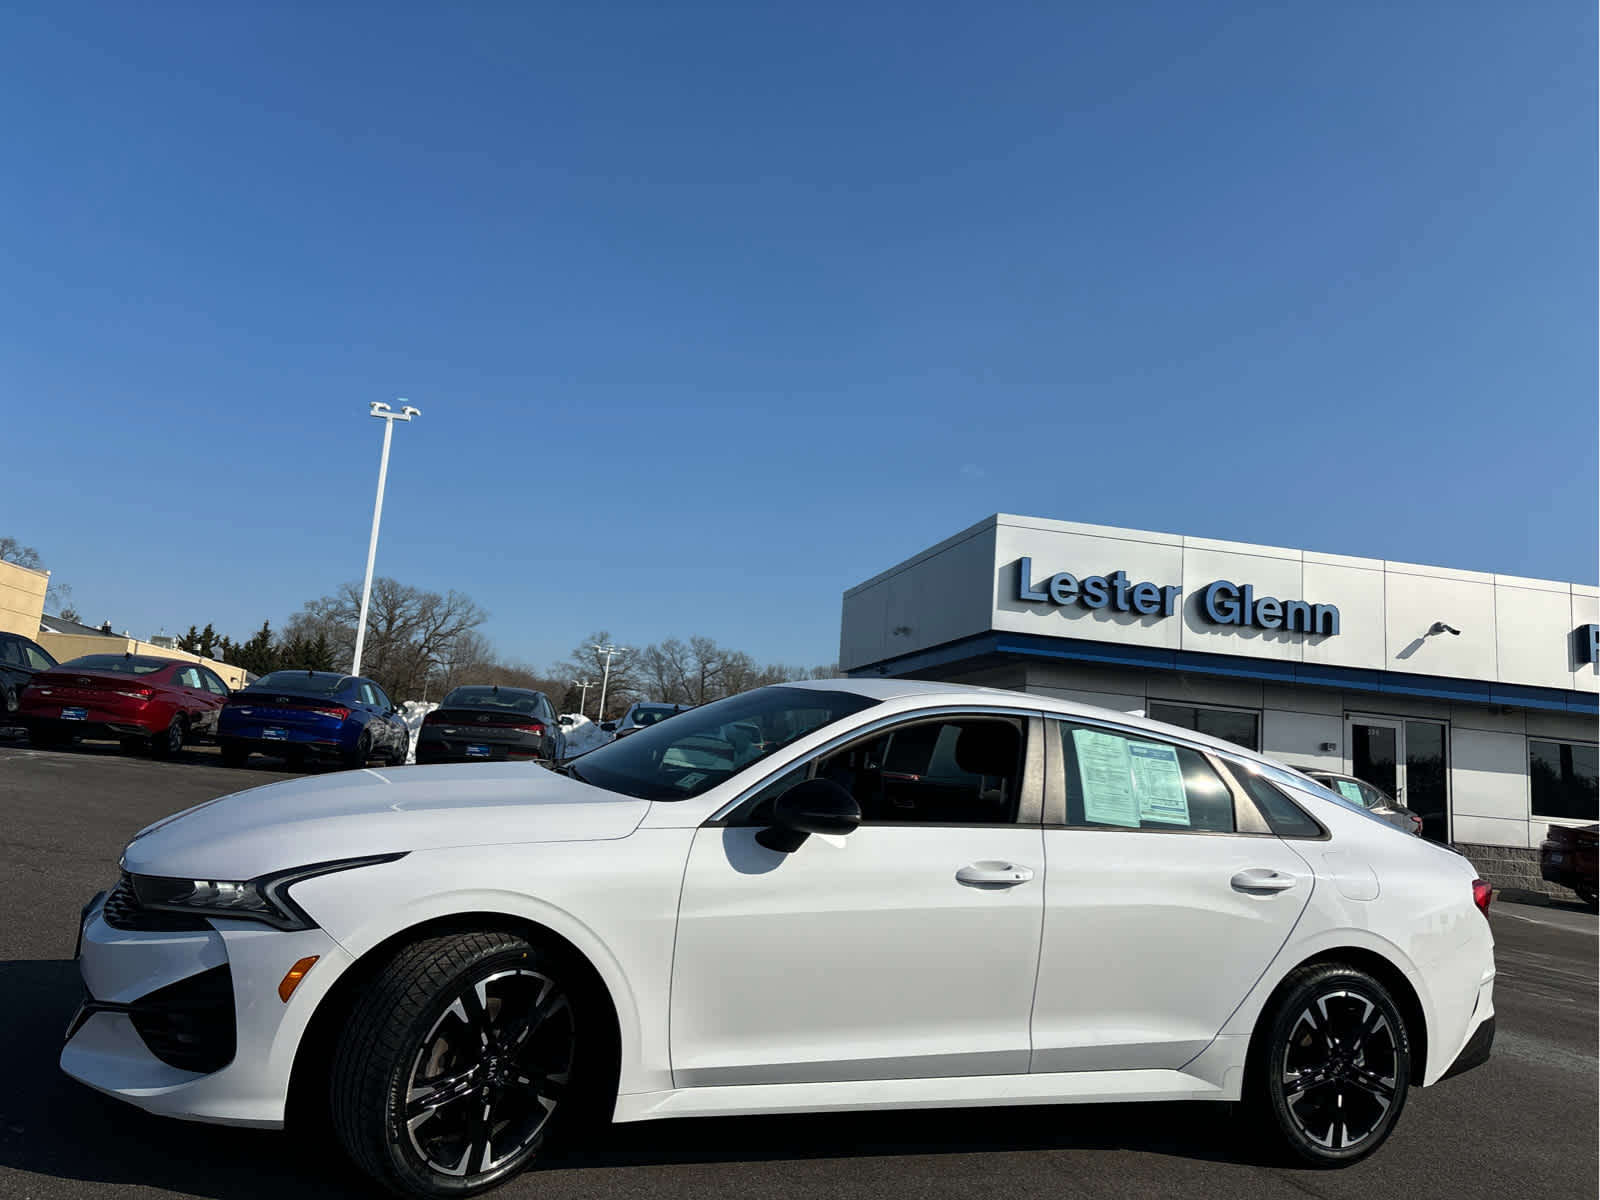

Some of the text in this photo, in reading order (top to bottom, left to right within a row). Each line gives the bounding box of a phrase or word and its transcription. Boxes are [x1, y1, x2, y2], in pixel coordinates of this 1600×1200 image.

[1018, 556, 1340, 637] Lester Glenn
[487, 1058, 498, 1079] KIA
